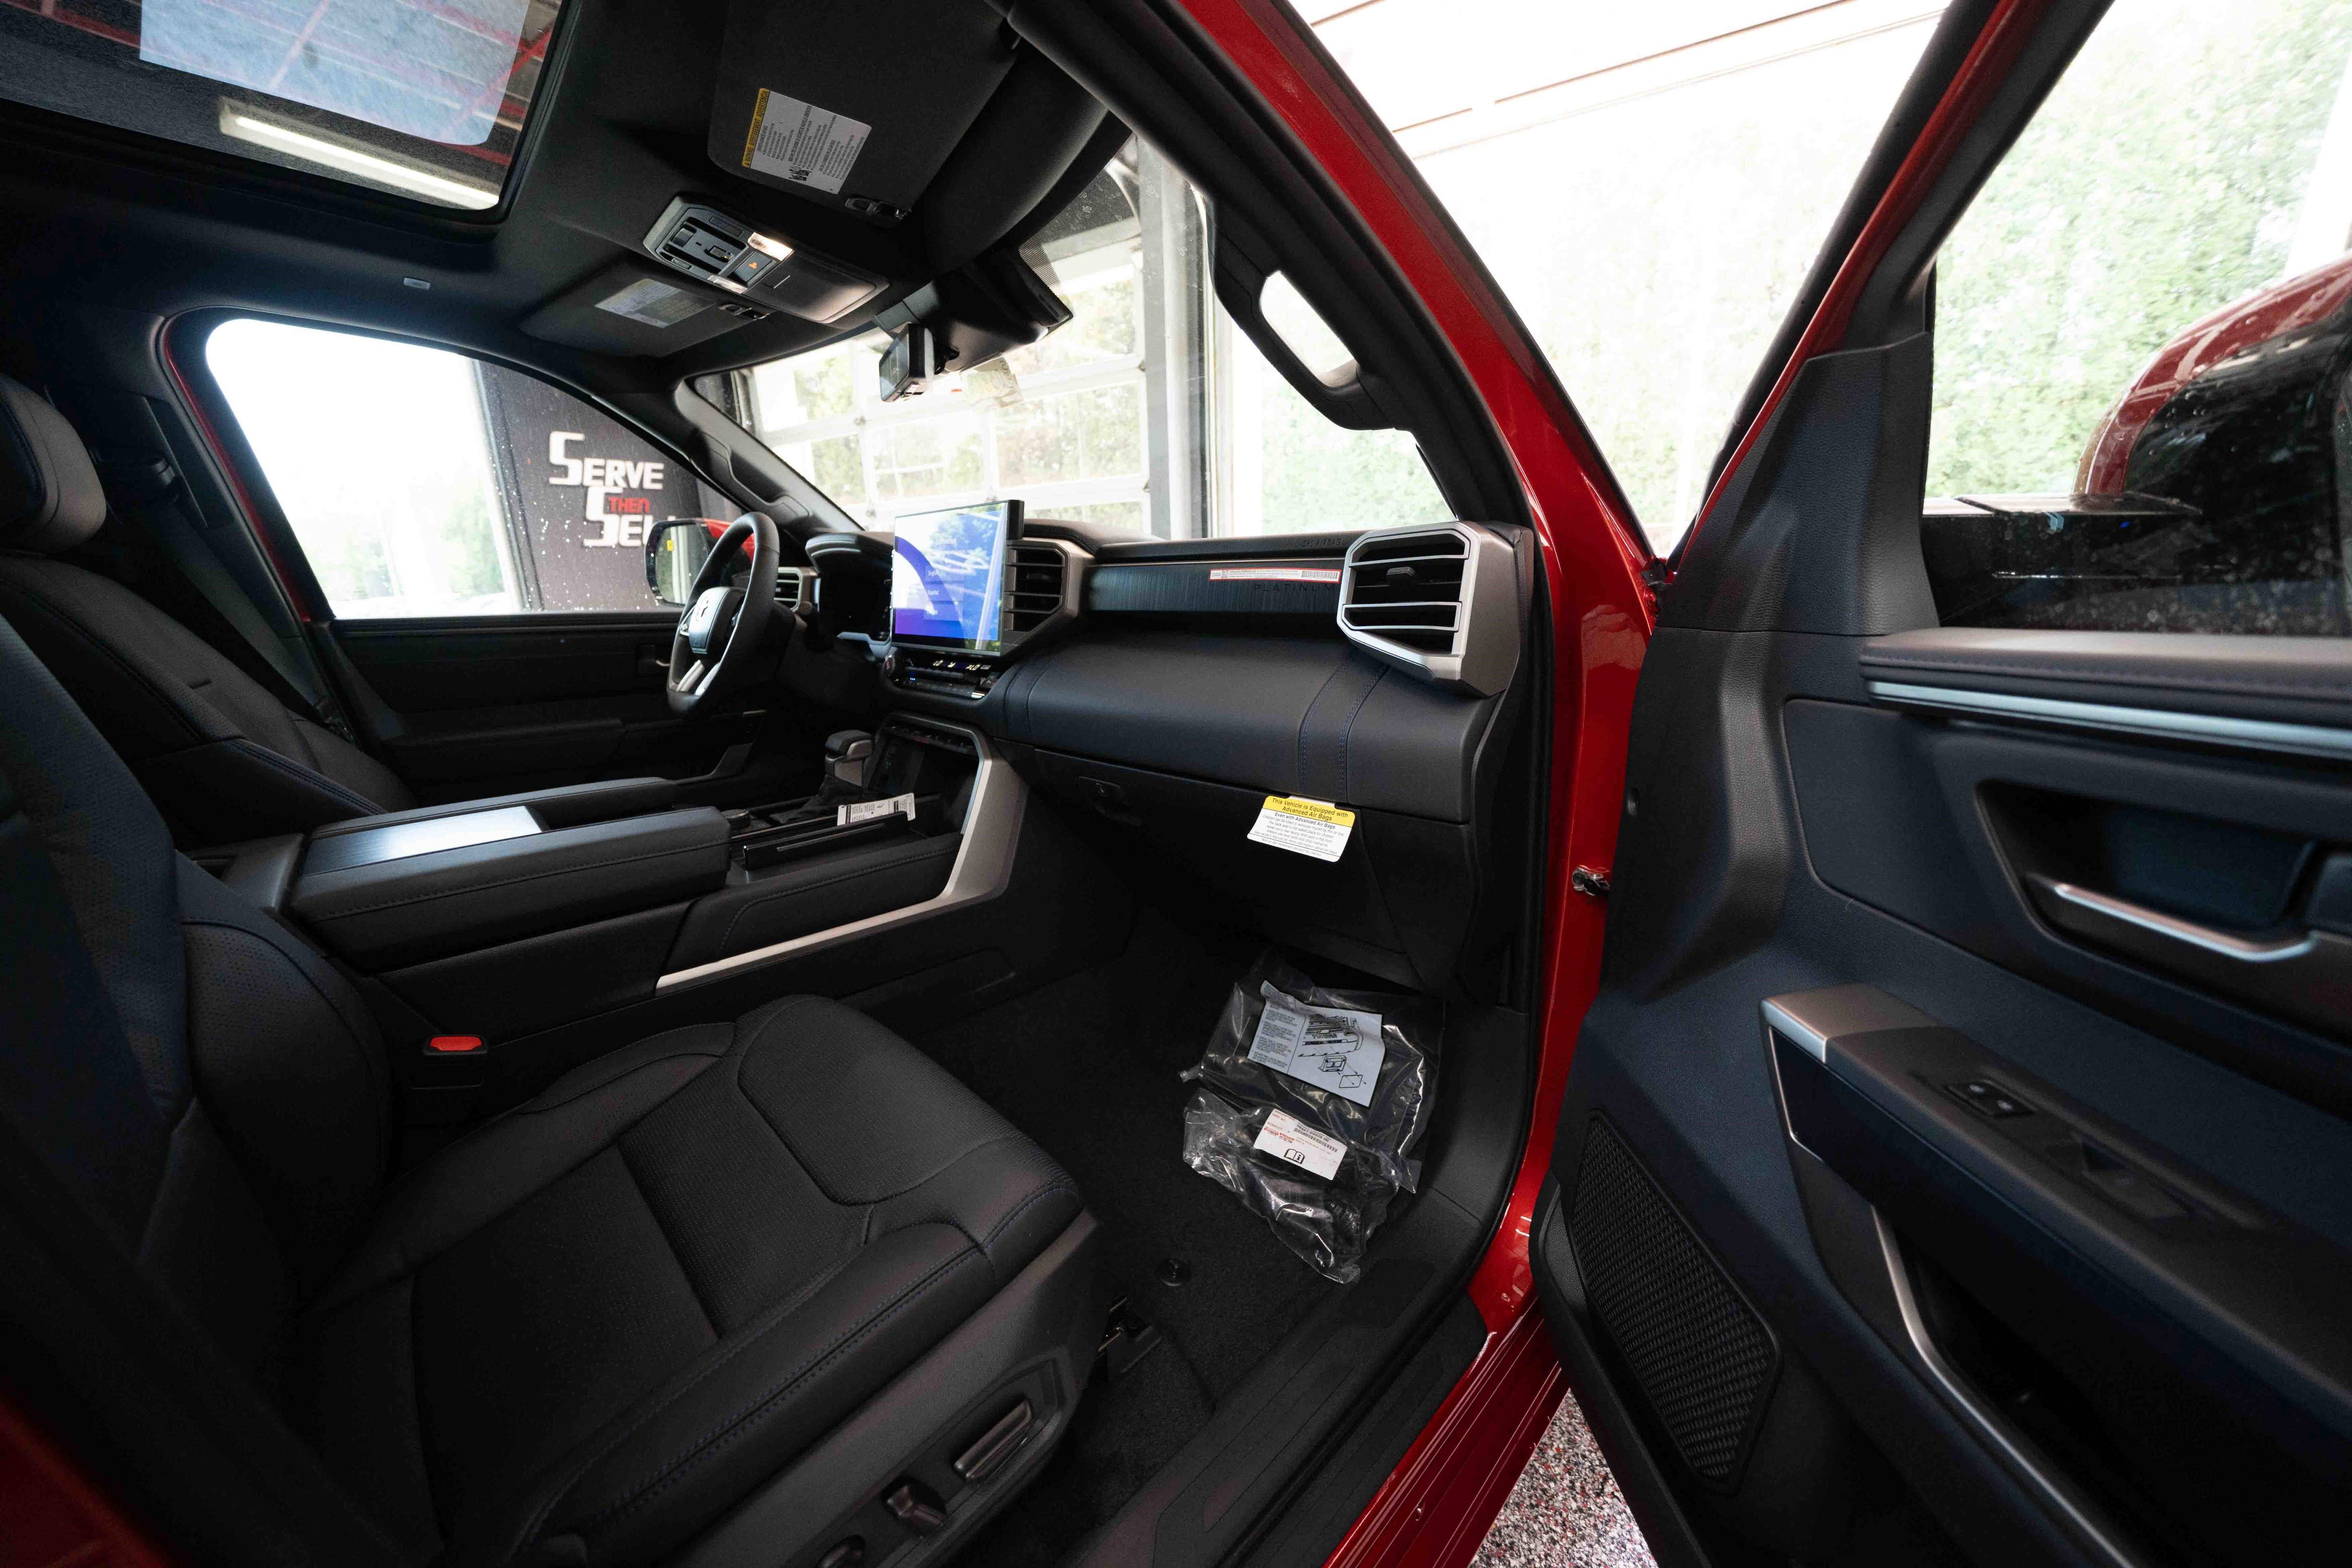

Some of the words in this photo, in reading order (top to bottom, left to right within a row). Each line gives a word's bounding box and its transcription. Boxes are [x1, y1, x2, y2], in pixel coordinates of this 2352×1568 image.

[756, 91, 768, 118] ADVERTENCIA
[549, 431, 664, 490] SERVE
[608, 497, 650, 513] THEN
[583, 486, 676, 547] SEL
[1316, 539, 1341, 547] AIRBAG
[1254, 583, 1336, 592] PLATINUM
[1282, 806, 1308, 815] Advanced
[1310, 806, 1335, 816] Equipped
